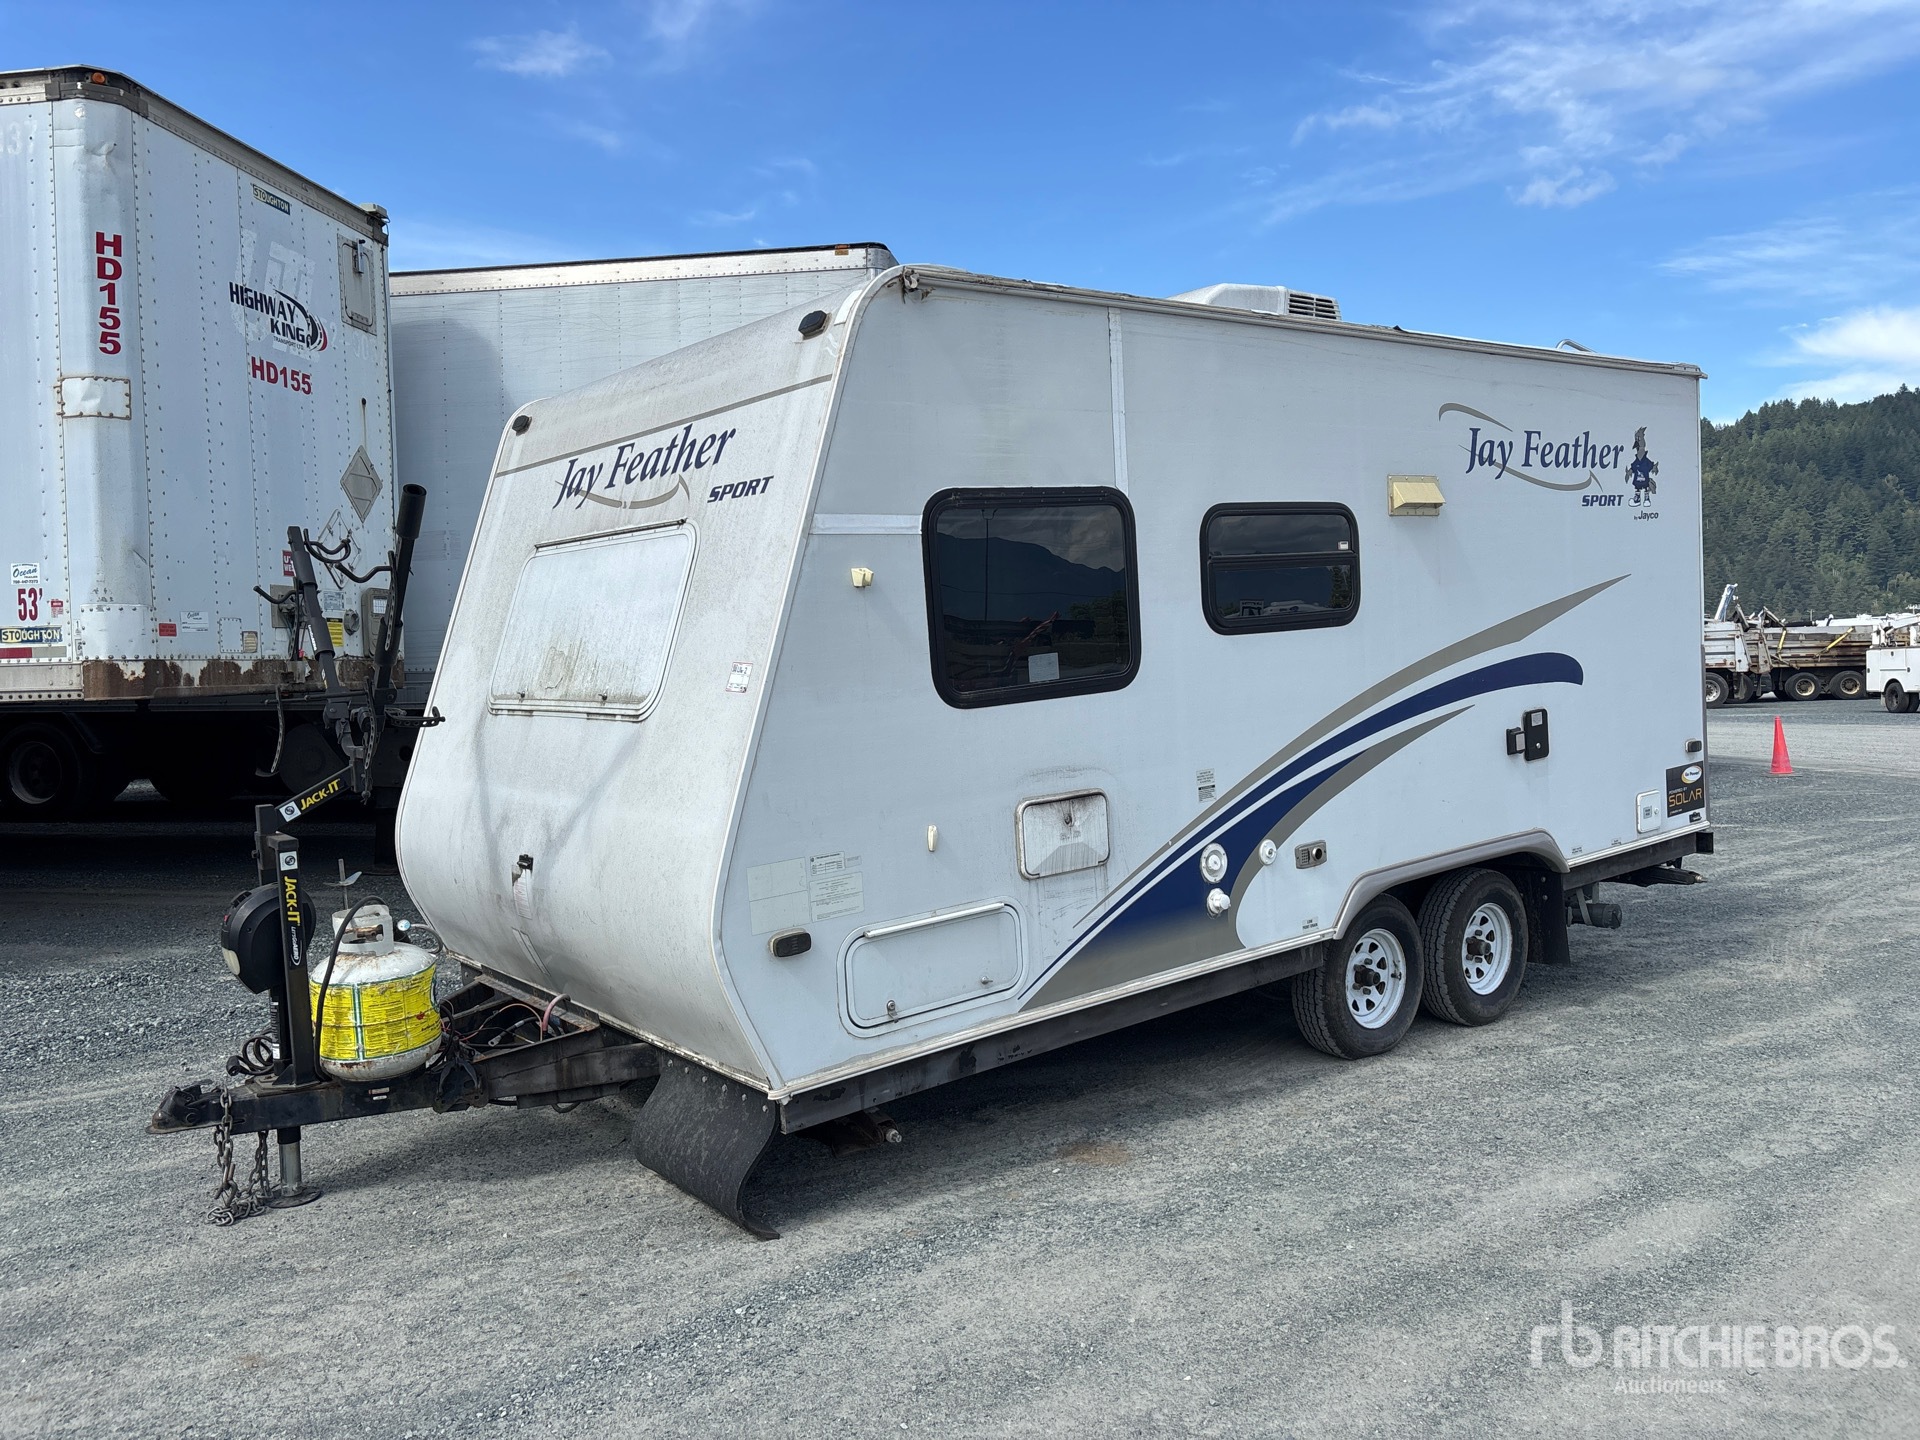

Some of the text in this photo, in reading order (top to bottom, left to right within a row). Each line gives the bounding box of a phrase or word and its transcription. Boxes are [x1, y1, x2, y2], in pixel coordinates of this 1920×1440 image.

[253, 187, 289, 212] STOUGHTON
[95, 231, 123, 355] HD155
[229, 281, 296, 324] HIGHWAY
[270, 317, 306, 344] KING
[251, 356, 313, 395] HD155
[552, 423, 736, 509] Jay Feather
[1465, 427, 1624, 480] Jay Feather
[707, 475, 775, 503] SPORT
[1581, 494, 1623, 507] SPORT
[1638, 511, 1659, 521] Jayco
[13, 568, 38, 578] Ocean
[17, 588, 43, 621] 53'
[1, 629, 60, 641] STOUGHTON
[300, 778, 341, 810] JACK-IT
[1668, 788, 1703, 807] SOLAR
[284, 876, 300, 926] JACK-IT
